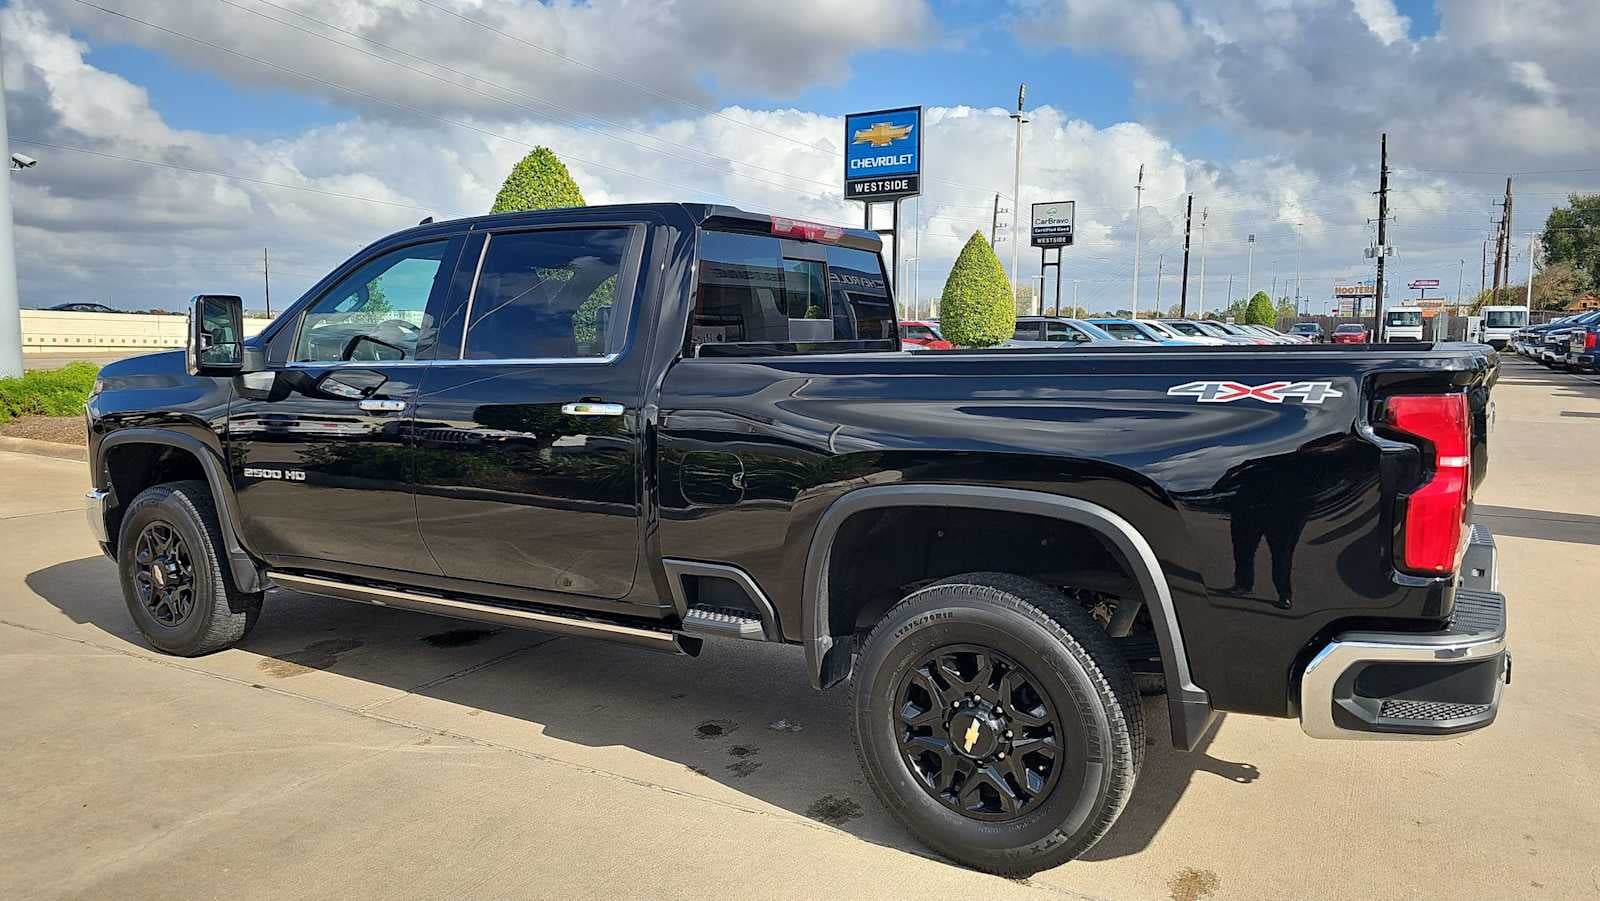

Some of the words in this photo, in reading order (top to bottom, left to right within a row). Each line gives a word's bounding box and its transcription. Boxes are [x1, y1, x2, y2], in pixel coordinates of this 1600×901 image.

[851, 154, 914, 169] CHEVROLET
[855, 180, 909, 193] WESTSIDE
[1035, 217, 1069, 225] CarBravo
[1335, 285, 1375, 295] HOOTERS
[243, 467, 282, 479] 2500
[284, 470, 306, 481] HD
